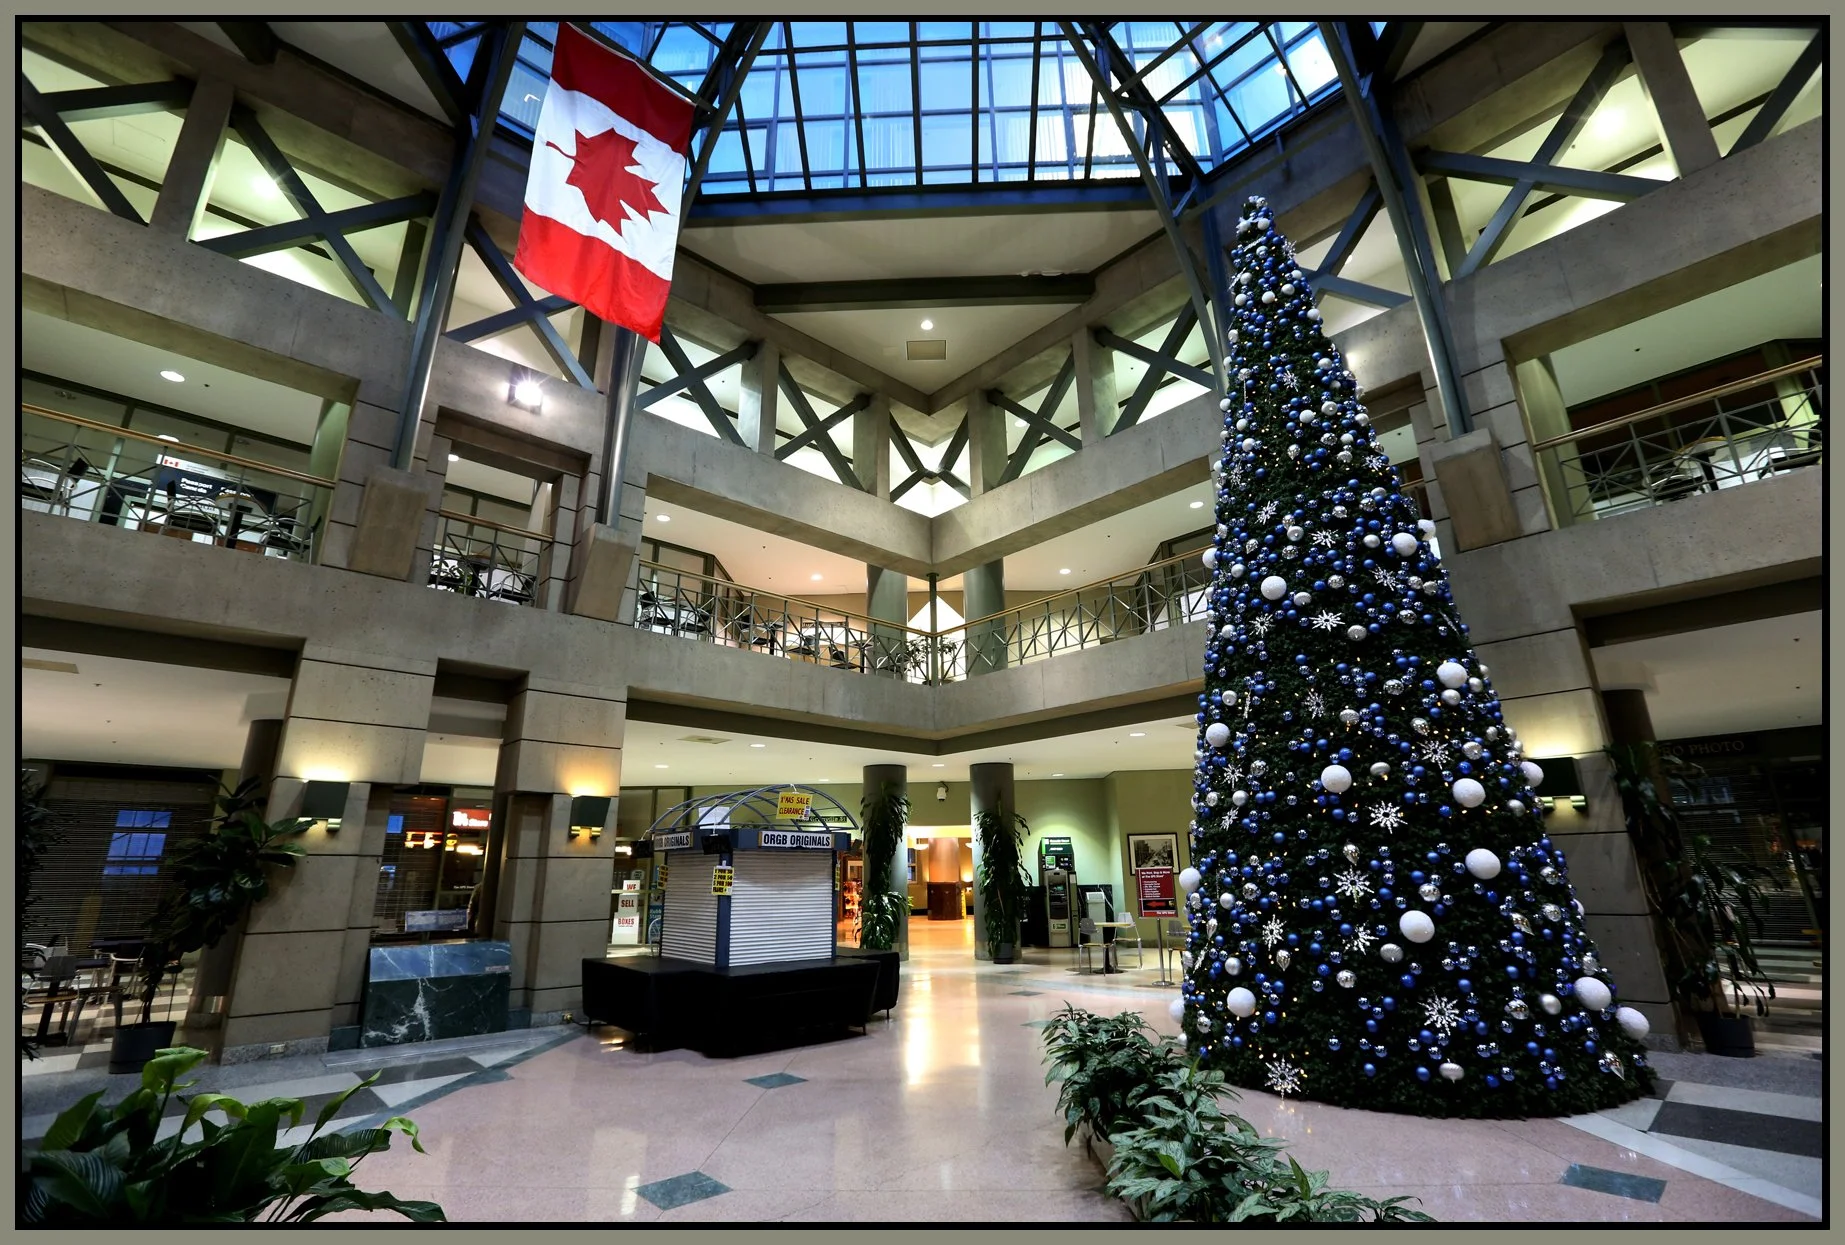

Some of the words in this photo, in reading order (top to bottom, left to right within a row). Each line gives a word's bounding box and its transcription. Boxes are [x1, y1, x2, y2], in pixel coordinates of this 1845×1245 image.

[1689, 740, 1745, 755] PHOTO
[796, 797, 810, 805] SALE
[779, 807, 805, 815] CLEARANCE
[763, 833, 788, 846] ORGB
[790, 834, 831, 847] ORIGINALS
[620, 899, 635, 908] SELL
